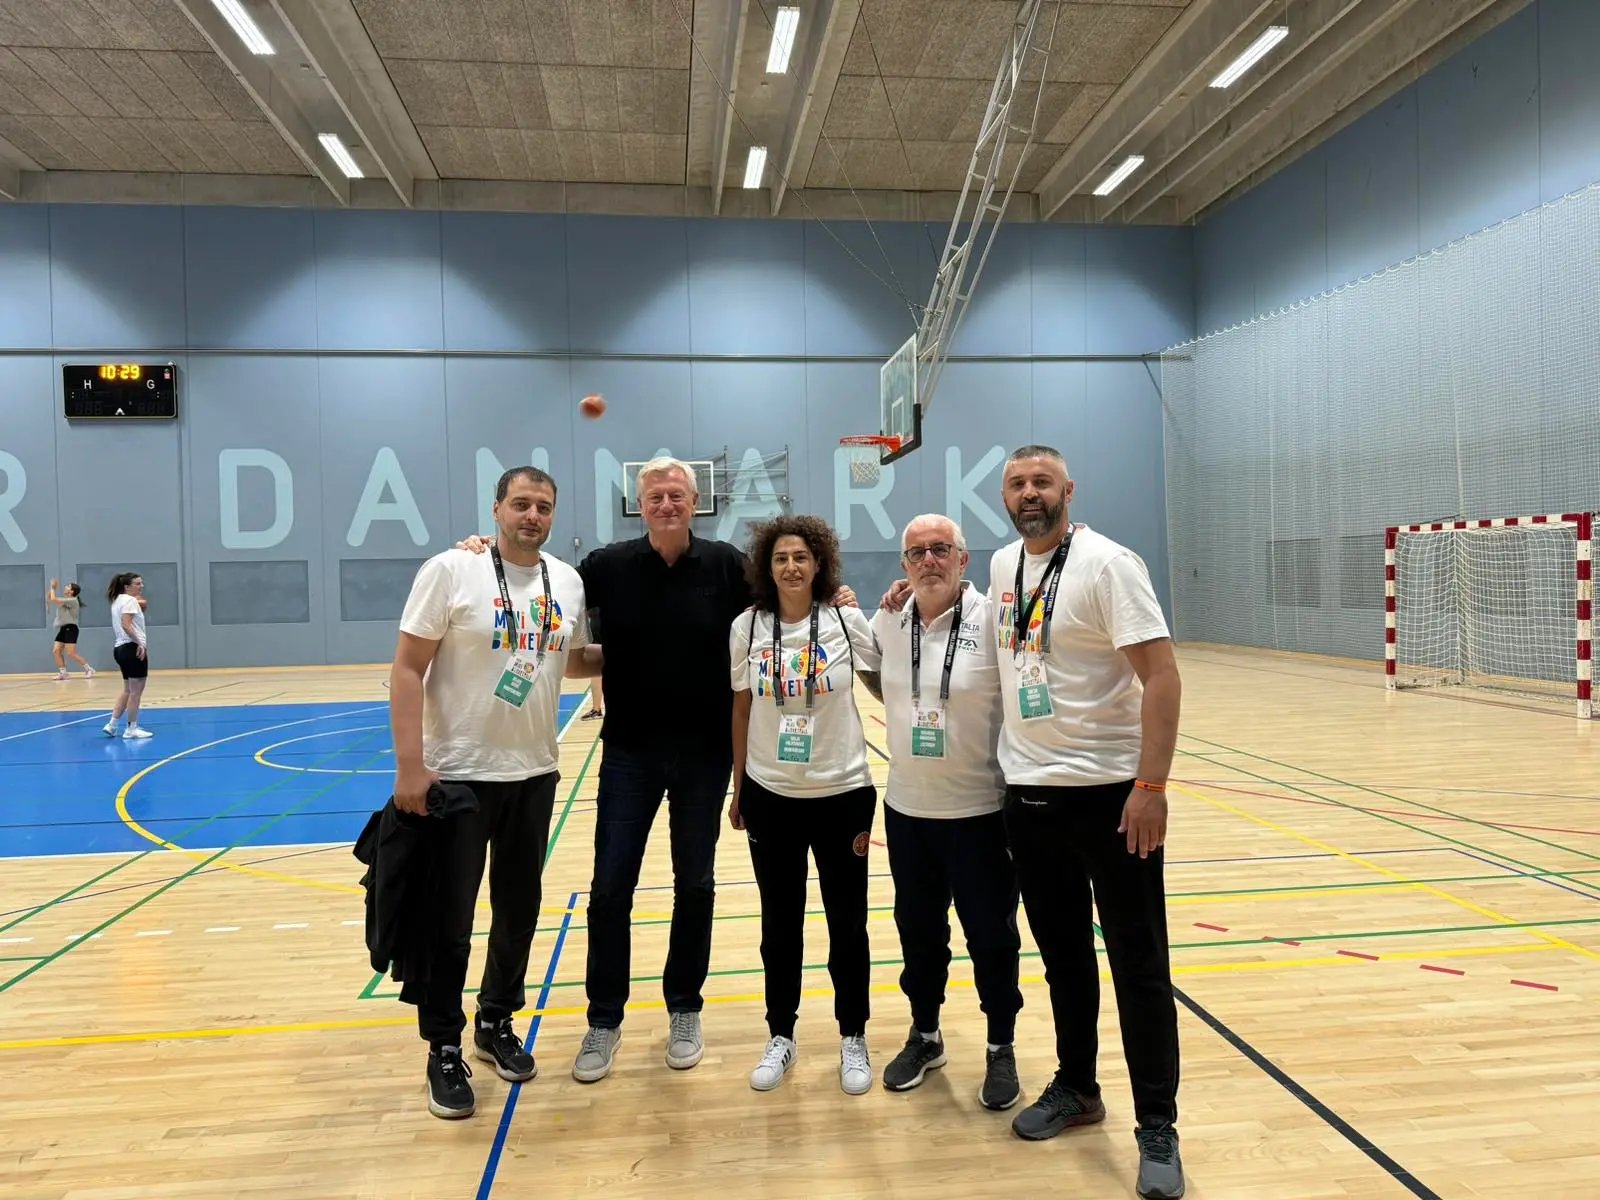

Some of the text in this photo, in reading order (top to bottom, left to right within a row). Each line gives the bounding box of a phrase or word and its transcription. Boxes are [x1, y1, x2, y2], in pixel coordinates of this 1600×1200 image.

[101, 364, 140, 380] 10:29
[84, 380, 92, 390] H
[146, 380, 155, 390] G
